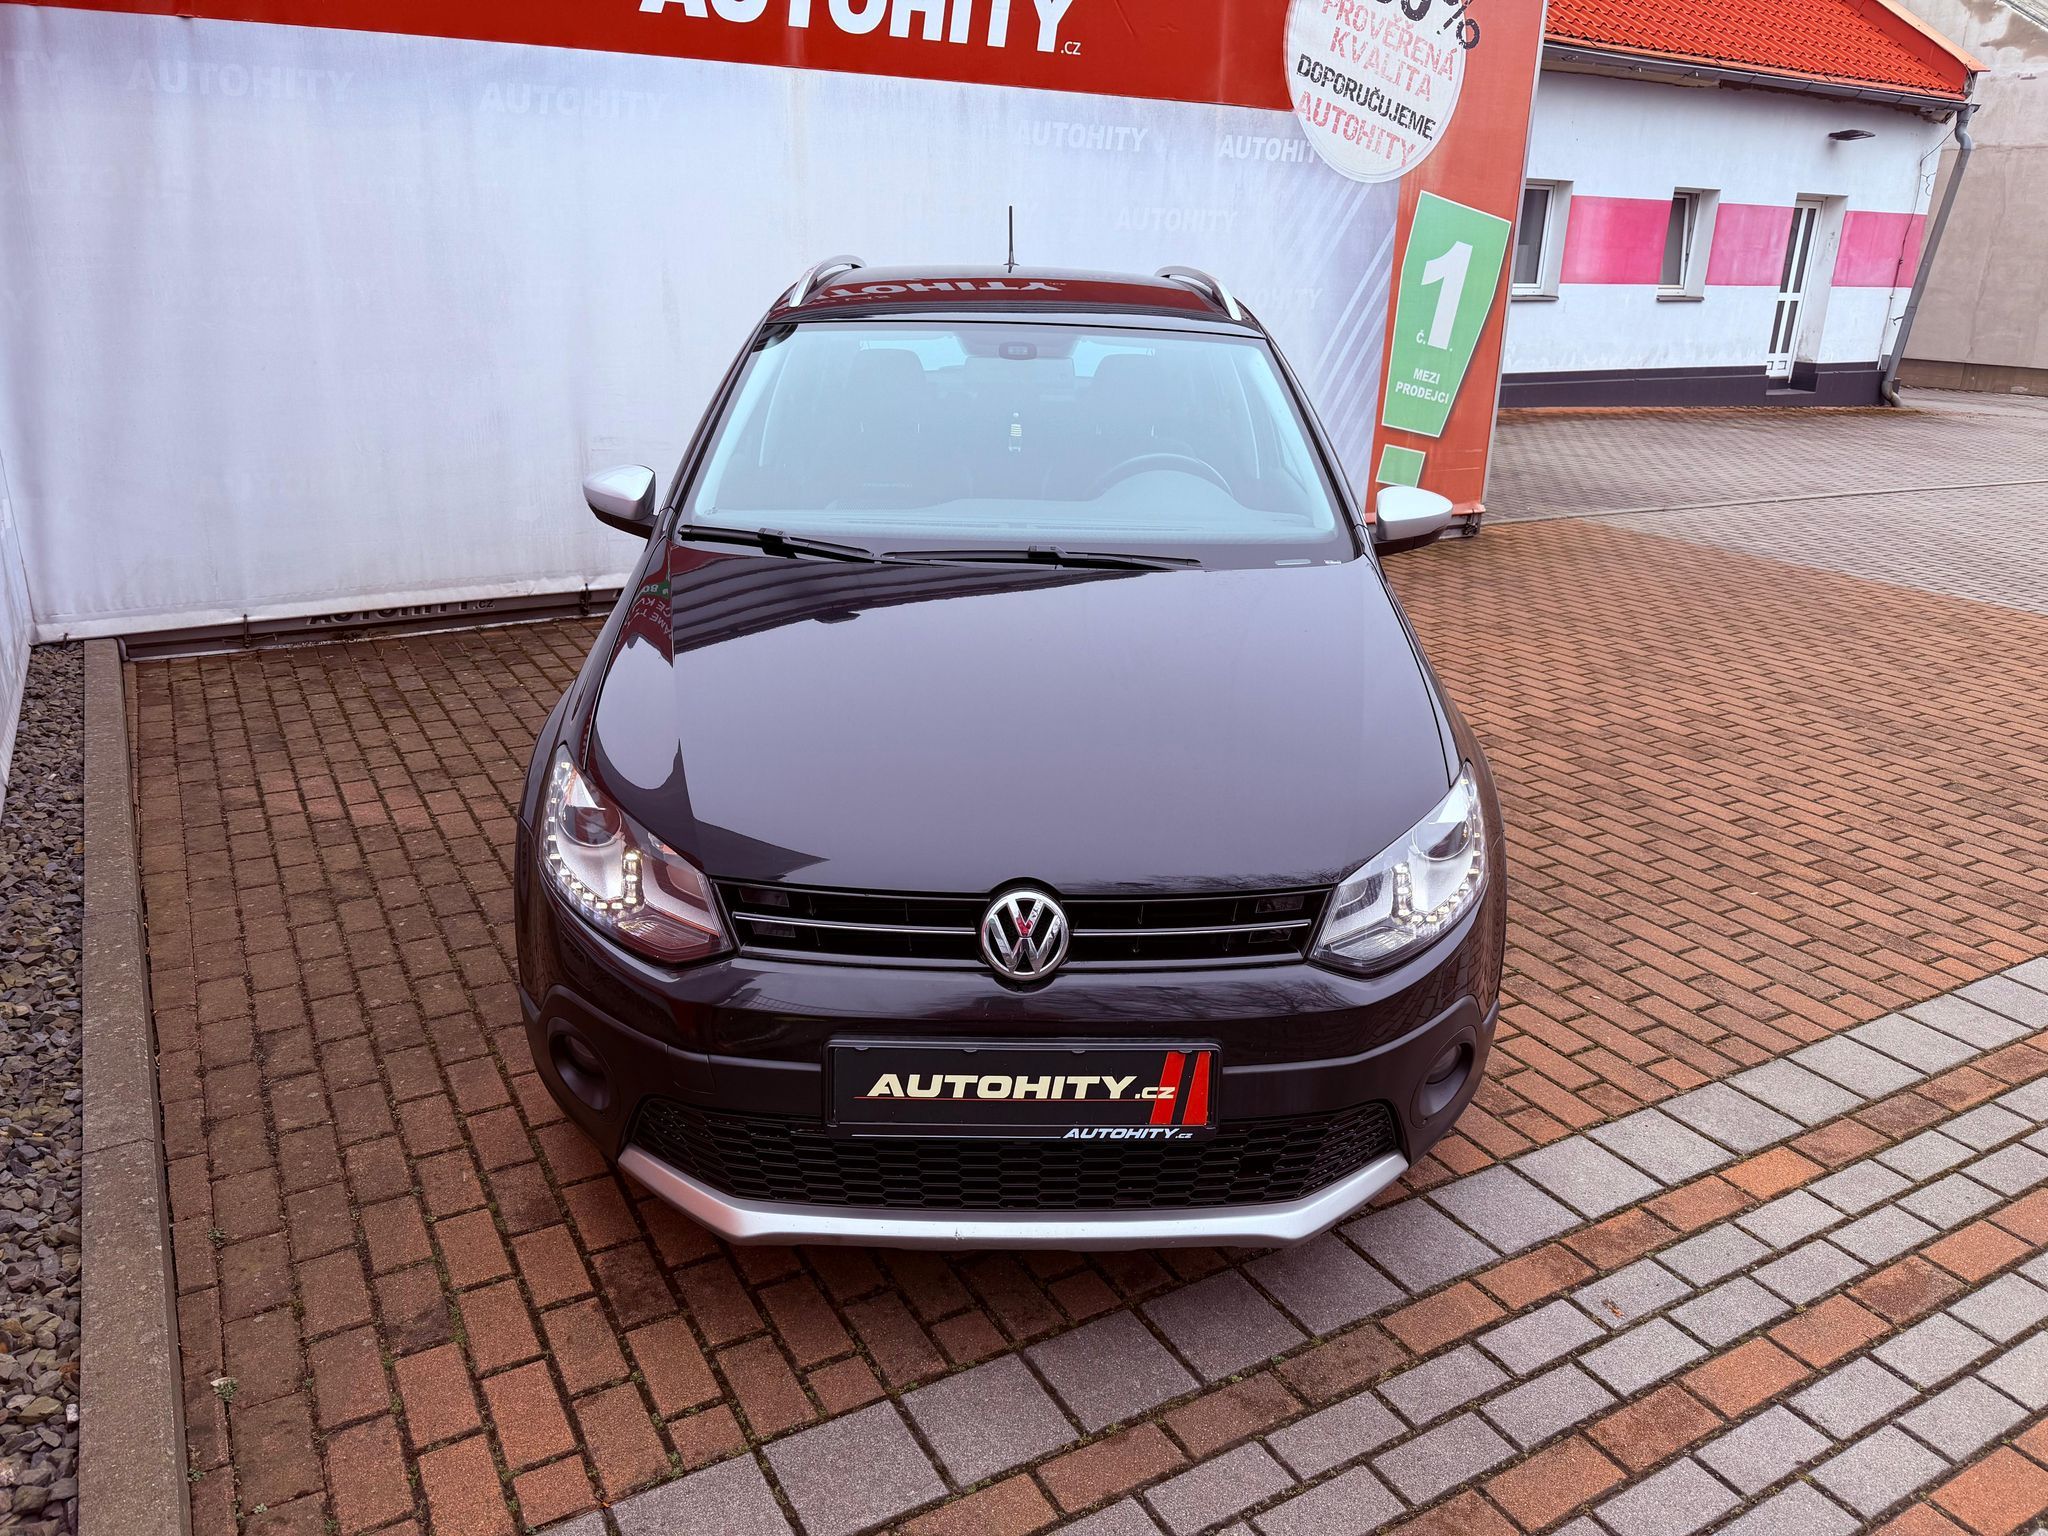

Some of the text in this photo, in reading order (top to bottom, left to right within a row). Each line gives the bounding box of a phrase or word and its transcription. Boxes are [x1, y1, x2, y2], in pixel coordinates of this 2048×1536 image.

[127, 58, 355, 103] AUTOHITY
[1331, 27, 1432, 102] KVALITA
[478, 82, 667, 121] AUTOHITY
[1296, 54, 1436, 141] DOPORUČUJEME
[1015, 120, 1148, 153] AUTOHITY
[1296, 91, 1416, 167] AUTOHITY
[1218, 134, 1316, 164] AUTOHIT
[1115, 206, 1238, 233] AUTOHITY
[1395, 381, 1449, 404] PRODEJCI
[1413, 367, 1441, 385] MEZI
